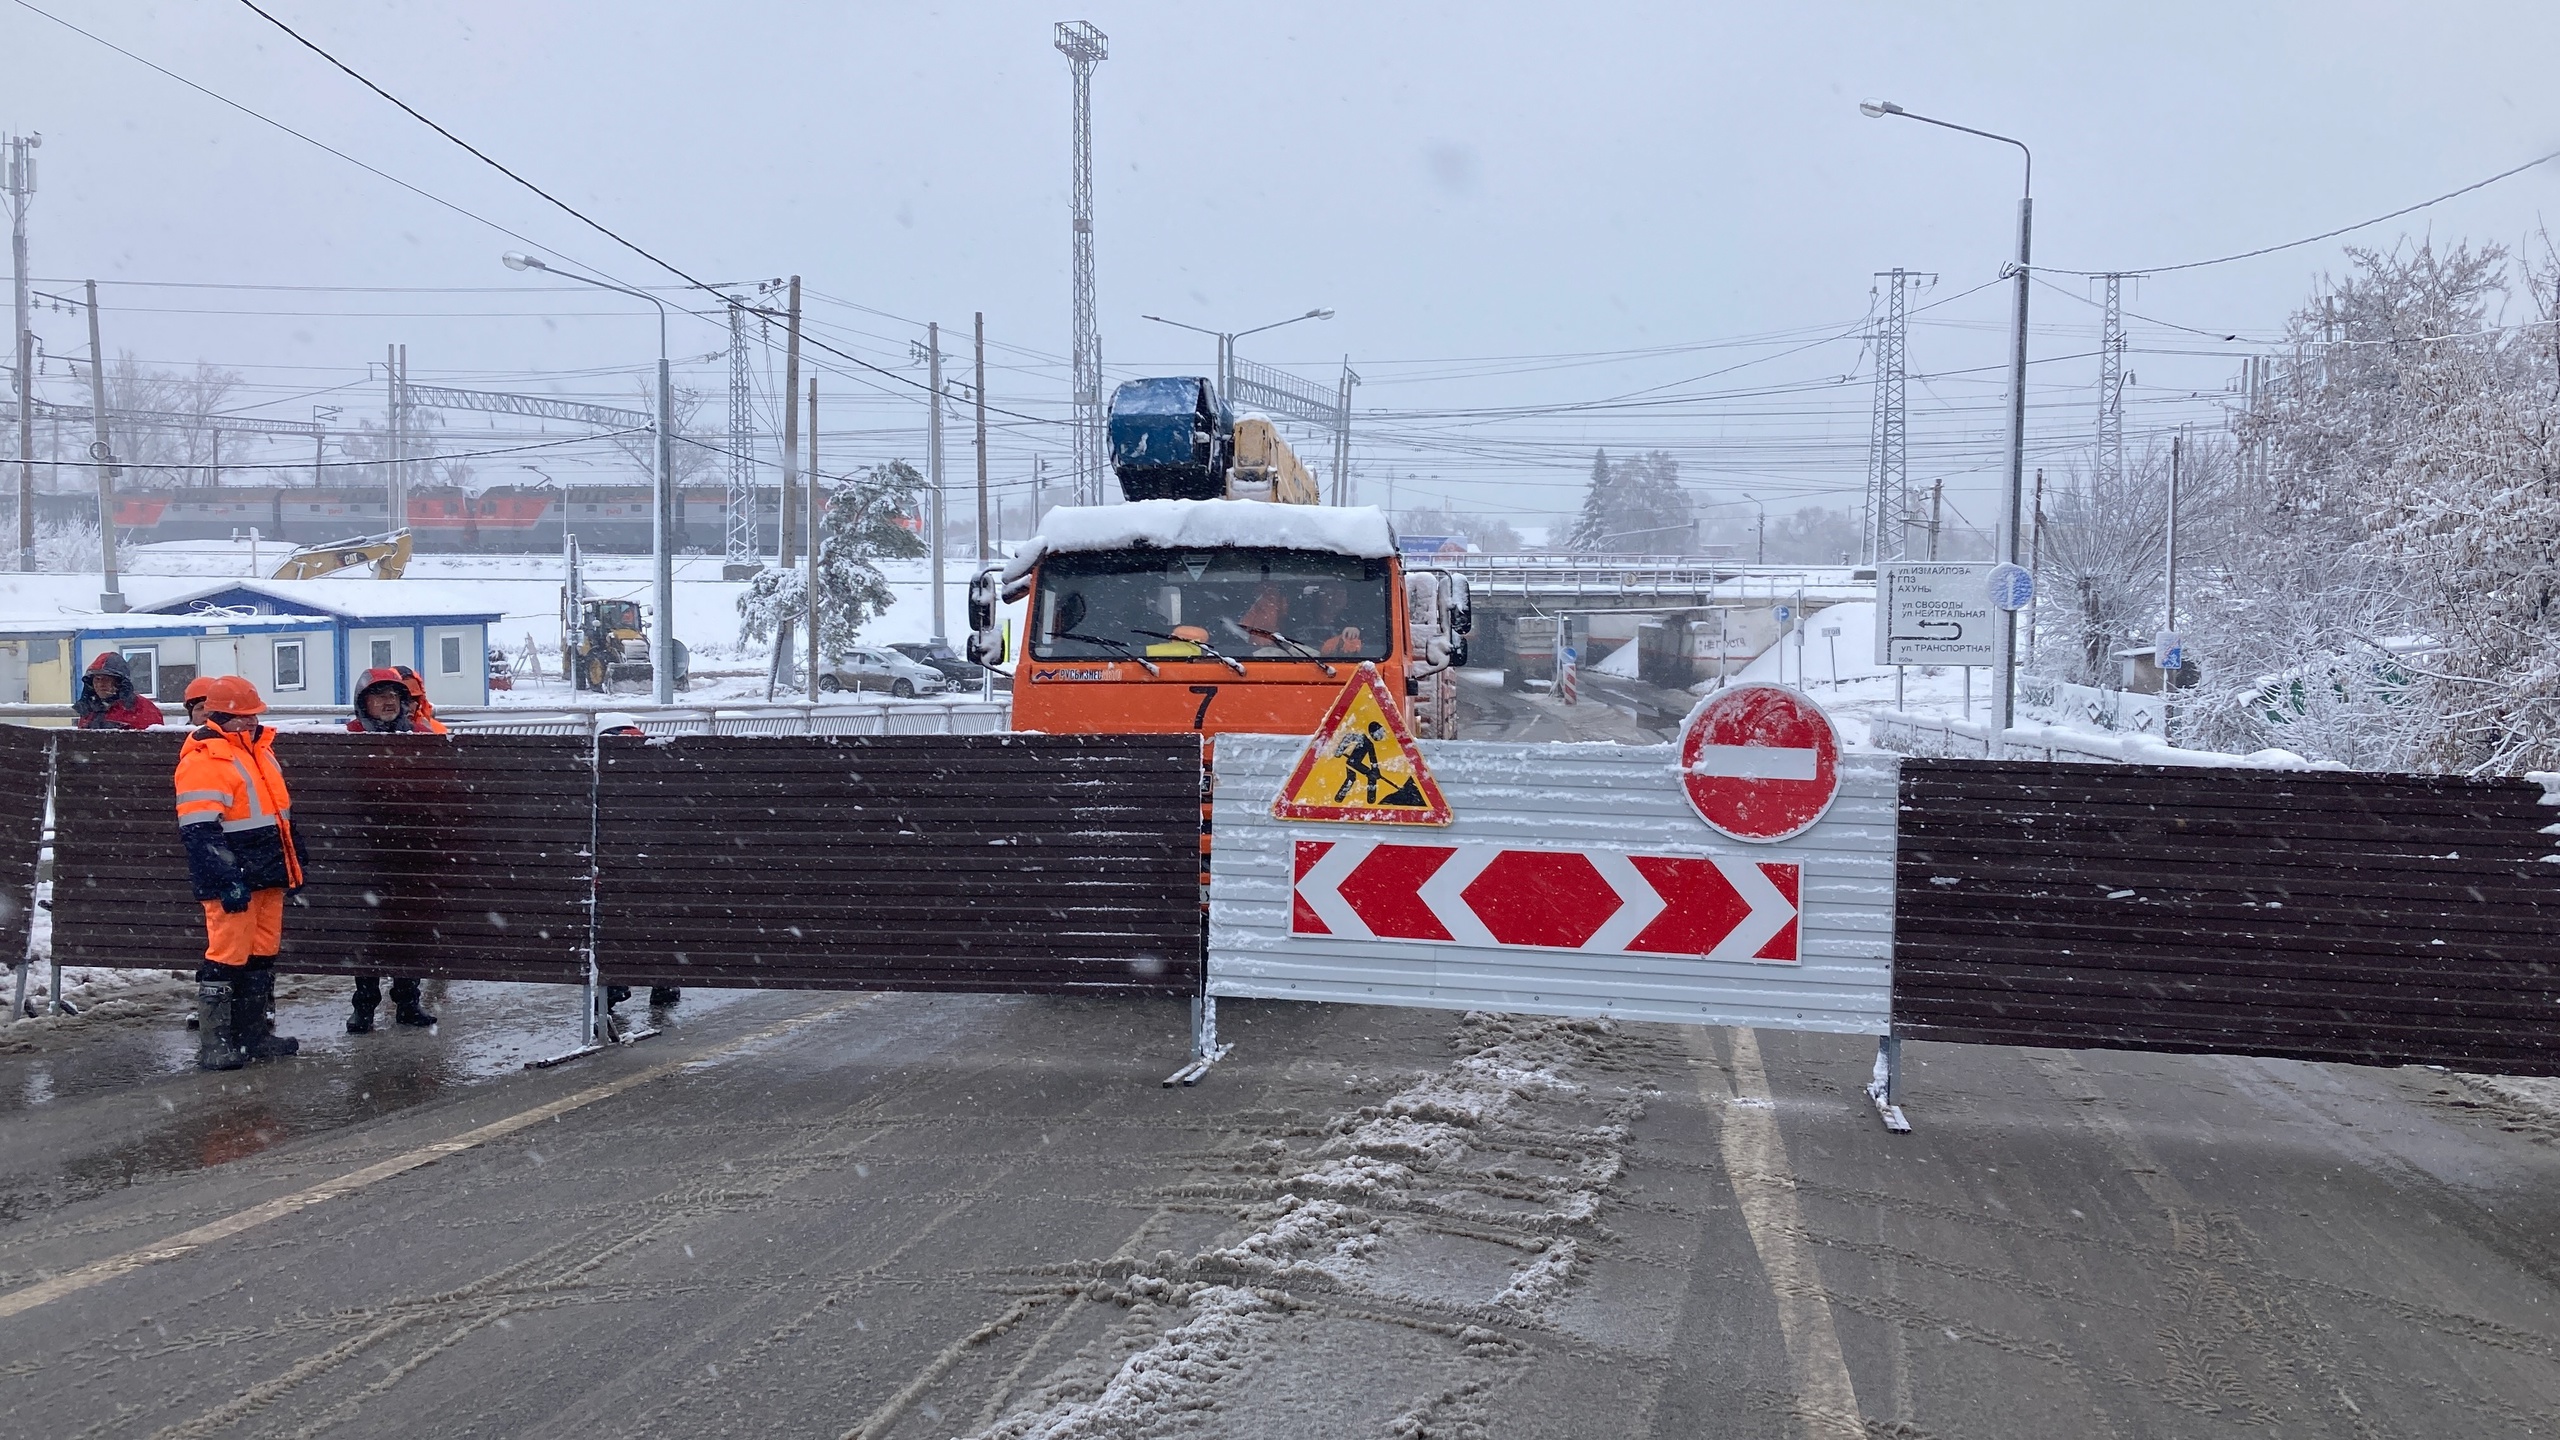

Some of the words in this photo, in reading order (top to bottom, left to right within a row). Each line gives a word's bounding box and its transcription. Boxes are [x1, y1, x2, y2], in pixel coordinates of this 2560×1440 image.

[344, 552, 358, 565] CAT
[1911, 566, 1971, 575] ИЗМАЙЛОВА
[1915, 601, 1963, 609] СВОБОДЫ
[1915, 609, 1986, 618] НЕЙТРАЛЬНАЯ
[1915, 644, 1991, 652] ТРАНСПОРТНАЯ
[1189, 686, 1218, 729] 7
